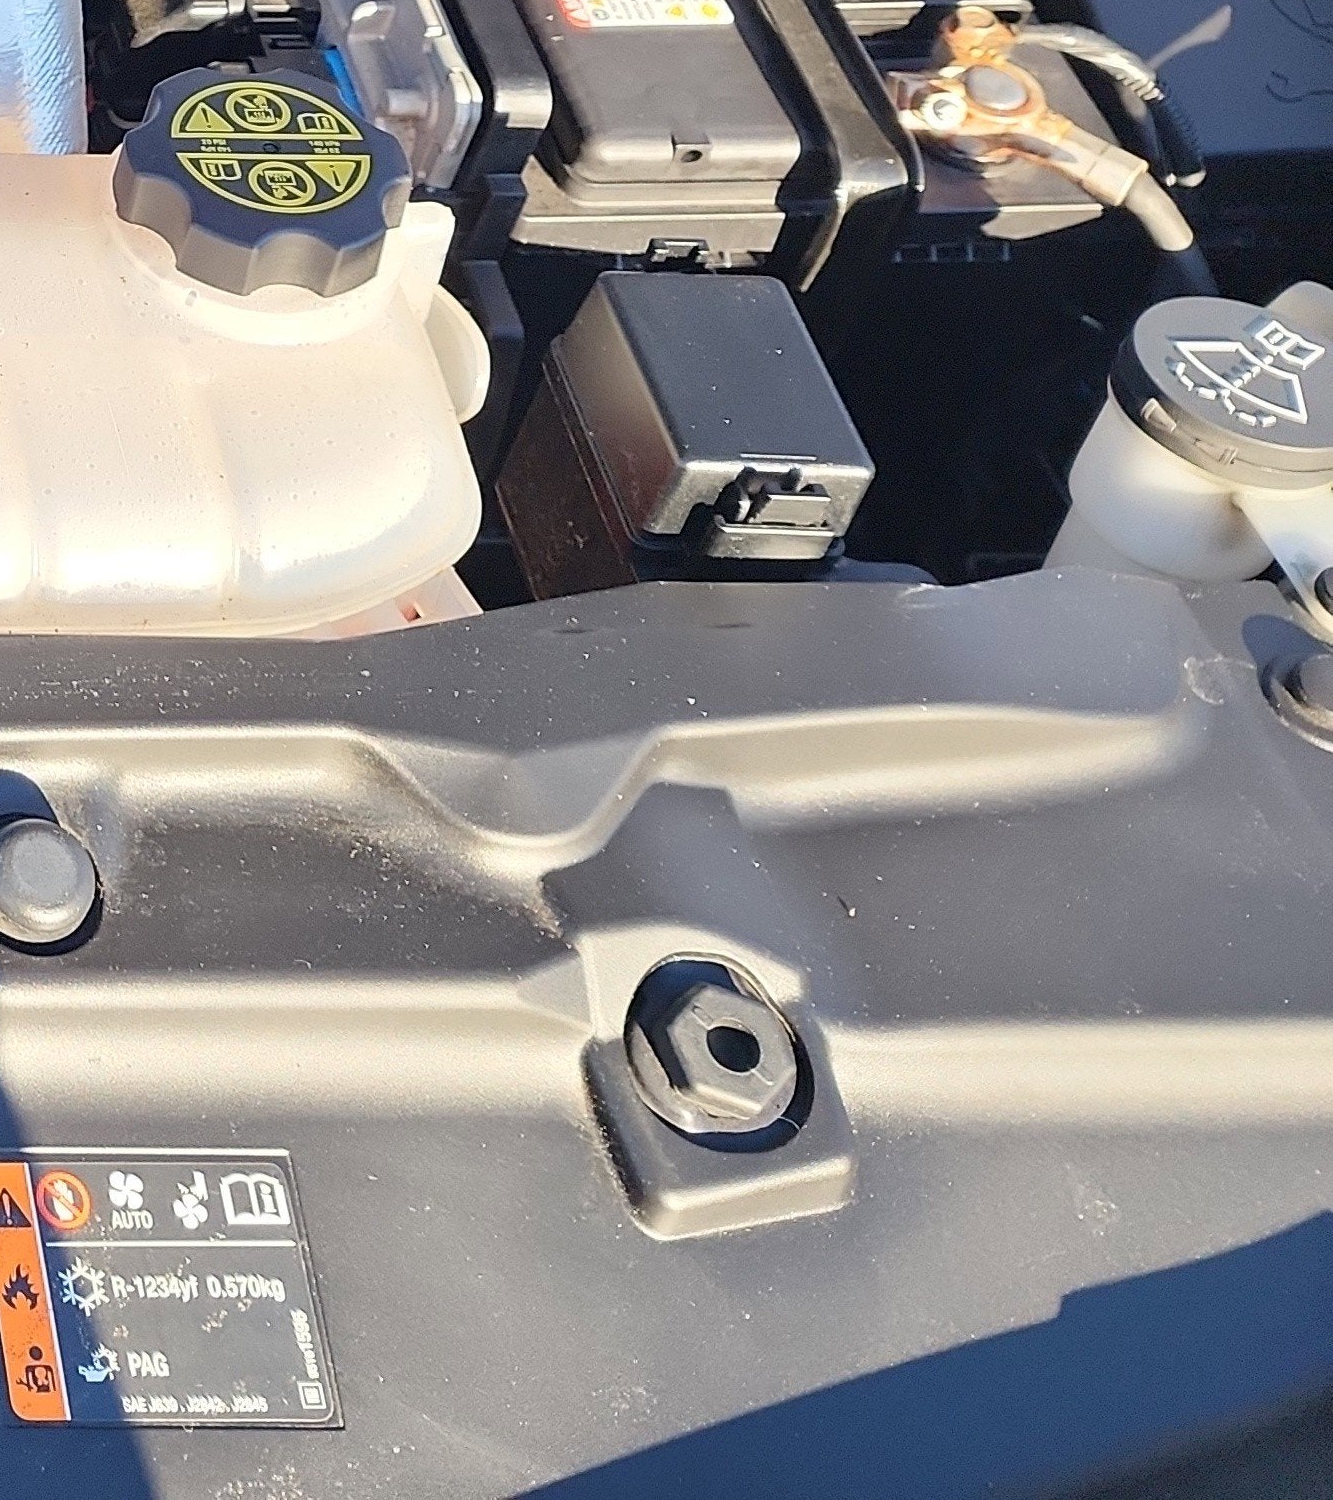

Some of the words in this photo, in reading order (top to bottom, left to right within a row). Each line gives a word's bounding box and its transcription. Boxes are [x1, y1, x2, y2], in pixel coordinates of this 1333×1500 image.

[111, 1210, 153, 1230] AUTO
[112, 1275, 197, 1302] R-1234yf
[206, 1275, 285, 1302] 0.570kg
[127, 1351, 170, 1378] PAG
[122, 1396, 148, 1413] SAE
